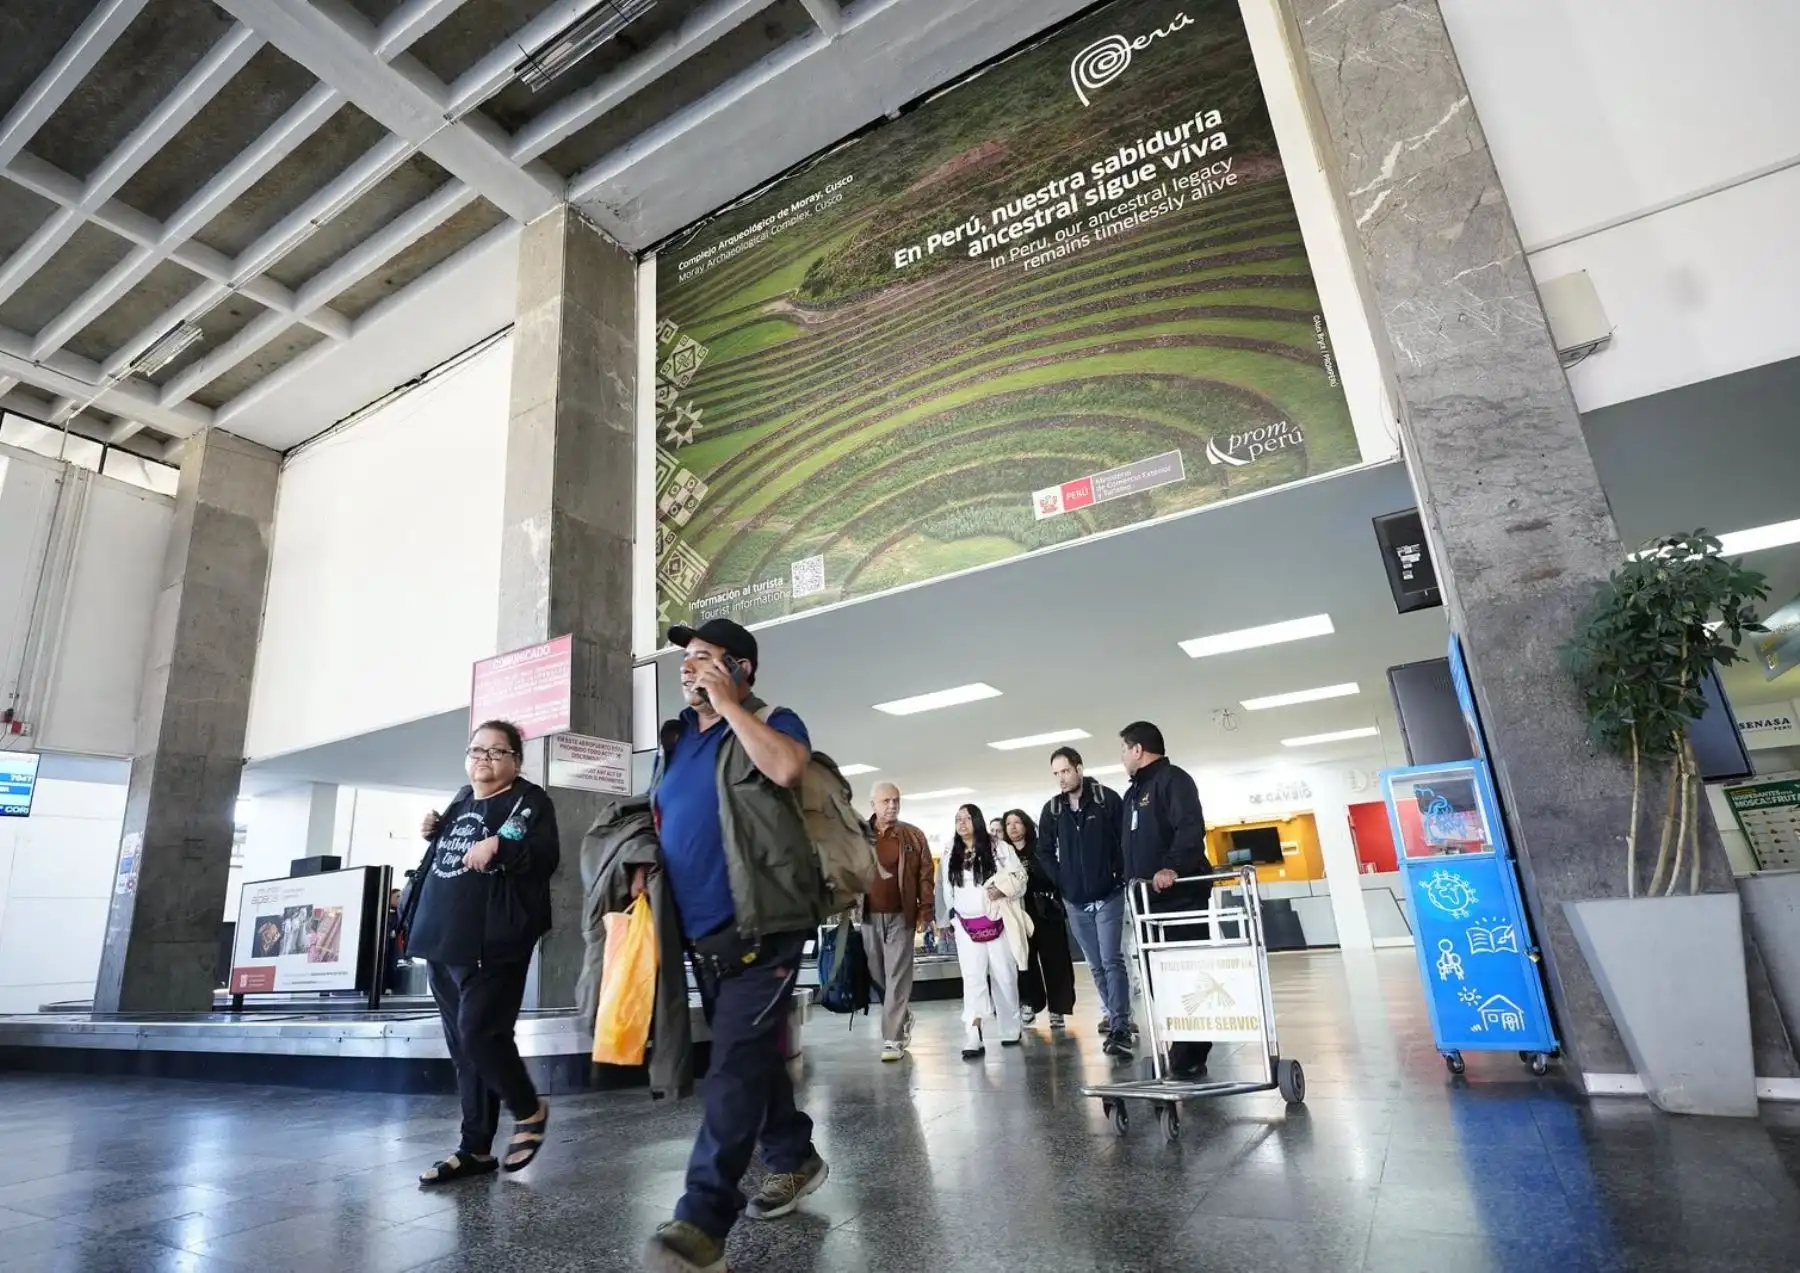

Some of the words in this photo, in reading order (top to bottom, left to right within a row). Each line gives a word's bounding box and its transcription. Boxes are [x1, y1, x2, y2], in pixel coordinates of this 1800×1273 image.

[1071, 12, 1194, 107] Perú
[678, 245, 717, 271] Complejo
[718, 214, 775, 251] Arqueológico
[776, 207, 789, 220] de
[791, 192, 824, 213] Moray,
[825, 174, 854, 194] Cusco
[894, 245, 922, 269] En
[927, 216, 987, 252] Perú,
[991, 172, 1086, 225] nuestra
[1091, 109, 1223, 182] sabiduría
[968, 199, 1078, 257] ancestral
[1085, 162, 1157, 207] sigue
[1162, 131, 1228, 171] viva
[990, 255, 1006, 270] In
[1009, 240, 1051, 264] Peru,
[1055, 220, 1083, 241] our
[1088, 184, 1168, 230] ancestral
[1172, 157, 1234, 193] legacy
[1023, 236, 1090, 272] remains
[1094, 196, 1186, 242] timelessly
[1190, 171, 1238, 201] alive
[678, 266, 705, 283] Moray
[706, 230, 769, 267] Archaeological
[815, 193, 843, 212] Cusco
[1228, 419, 1289, 454] prom
[1248, 426, 1304, 462] perú
[688, 590, 741, 611] Información
[742, 583, 750, 595] al
[752, 577, 784, 593] turista
[700, 604, 731, 620] Tourist
[1738, 717, 1791, 729] SENASA
[1166, 1016, 1212, 1031] PRIVATE
